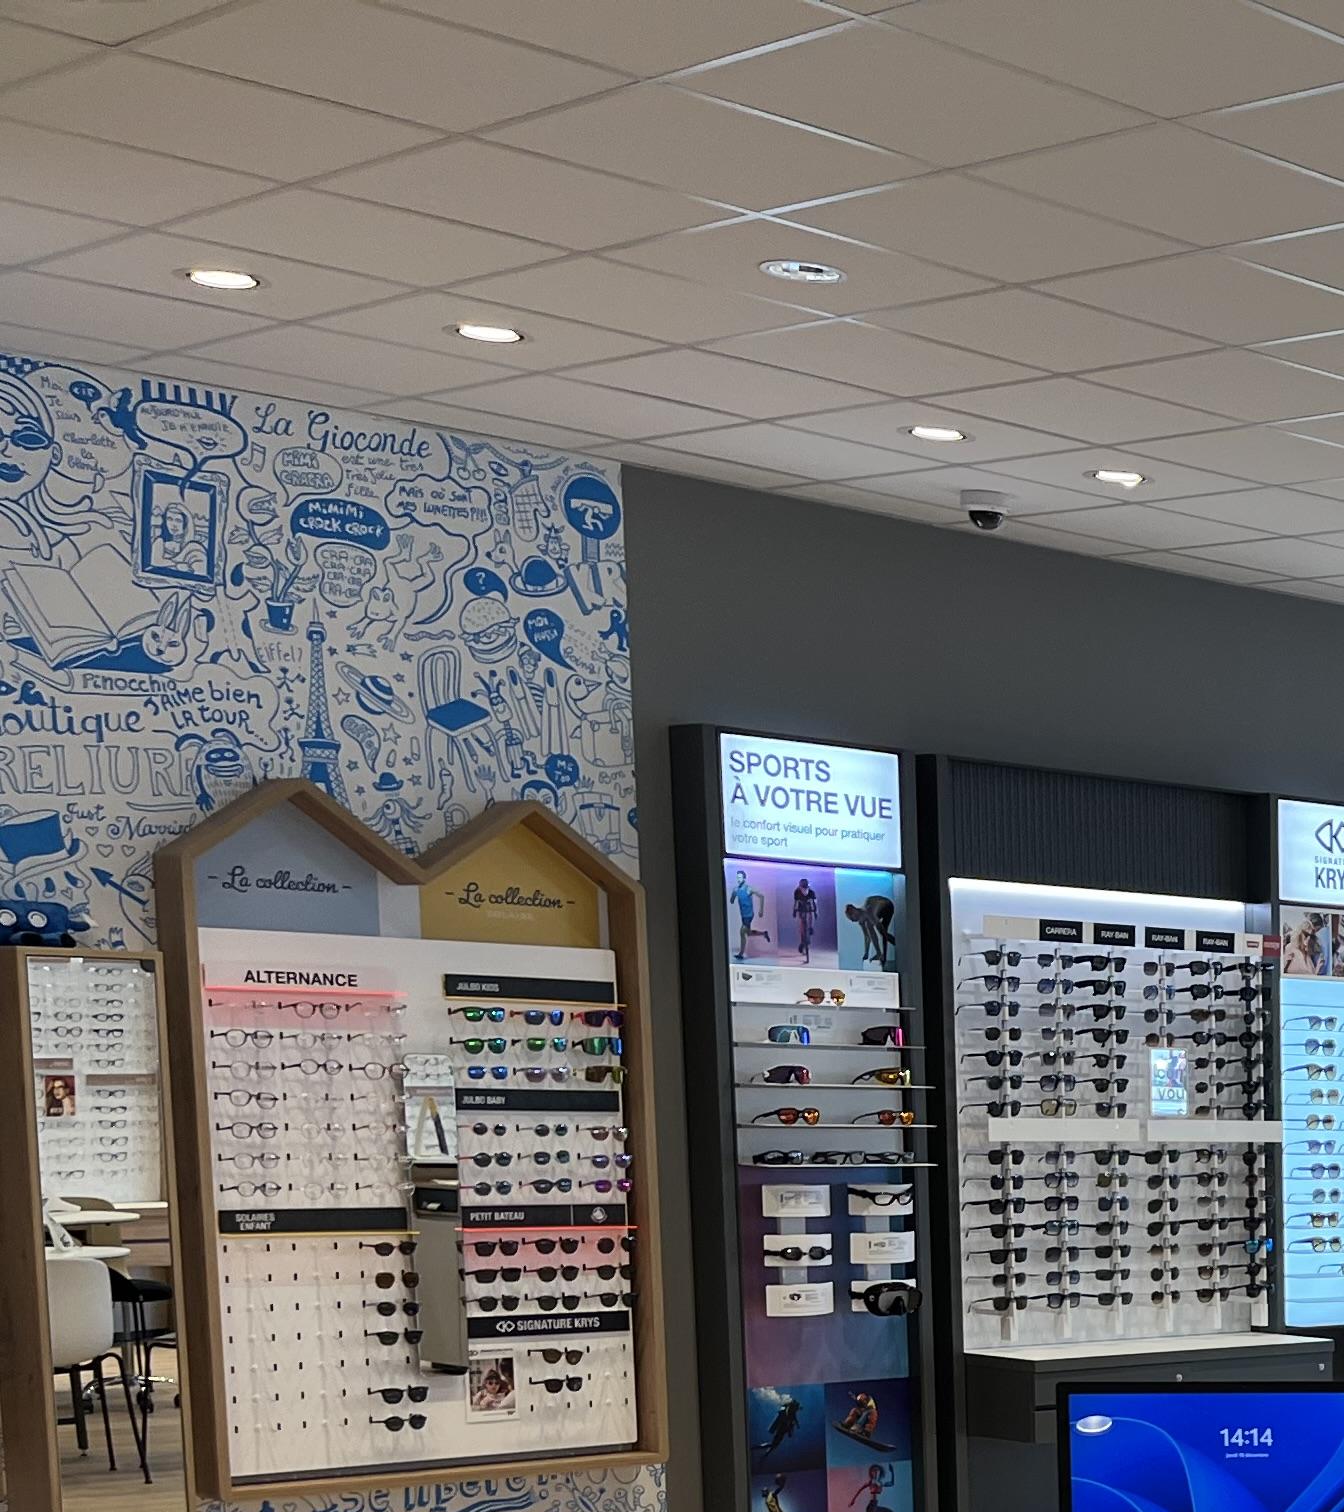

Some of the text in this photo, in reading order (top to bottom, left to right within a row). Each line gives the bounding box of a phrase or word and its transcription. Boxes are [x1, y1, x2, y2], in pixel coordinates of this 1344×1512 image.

[252, 403, 432, 458] La Gioconde
[82, 673, 177, 692] Pinocchio
[729, 749, 831, 783] SPORTS
[730, 776, 893, 820] À VOTRE VUE
[62, 802, 105, 823] Just
[742, 816, 781, 832] confort
[783, 822, 813, 835] visuel
[815, 826, 839, 838] pour
[841, 827, 885, 842] pratiquer
[732, 833, 788, 848] votre sport
[222, 865, 338, 894] La collection
[458, 882, 563, 910] La collection
[244, 970, 358, 988] ALTERNANCE
[470, 1212, 525, 1221] PETIT BATEAU
[516, 1316, 601, 1332] SIGNATURE KRYS
[1220, 1428, 1273, 1447] 14:14
